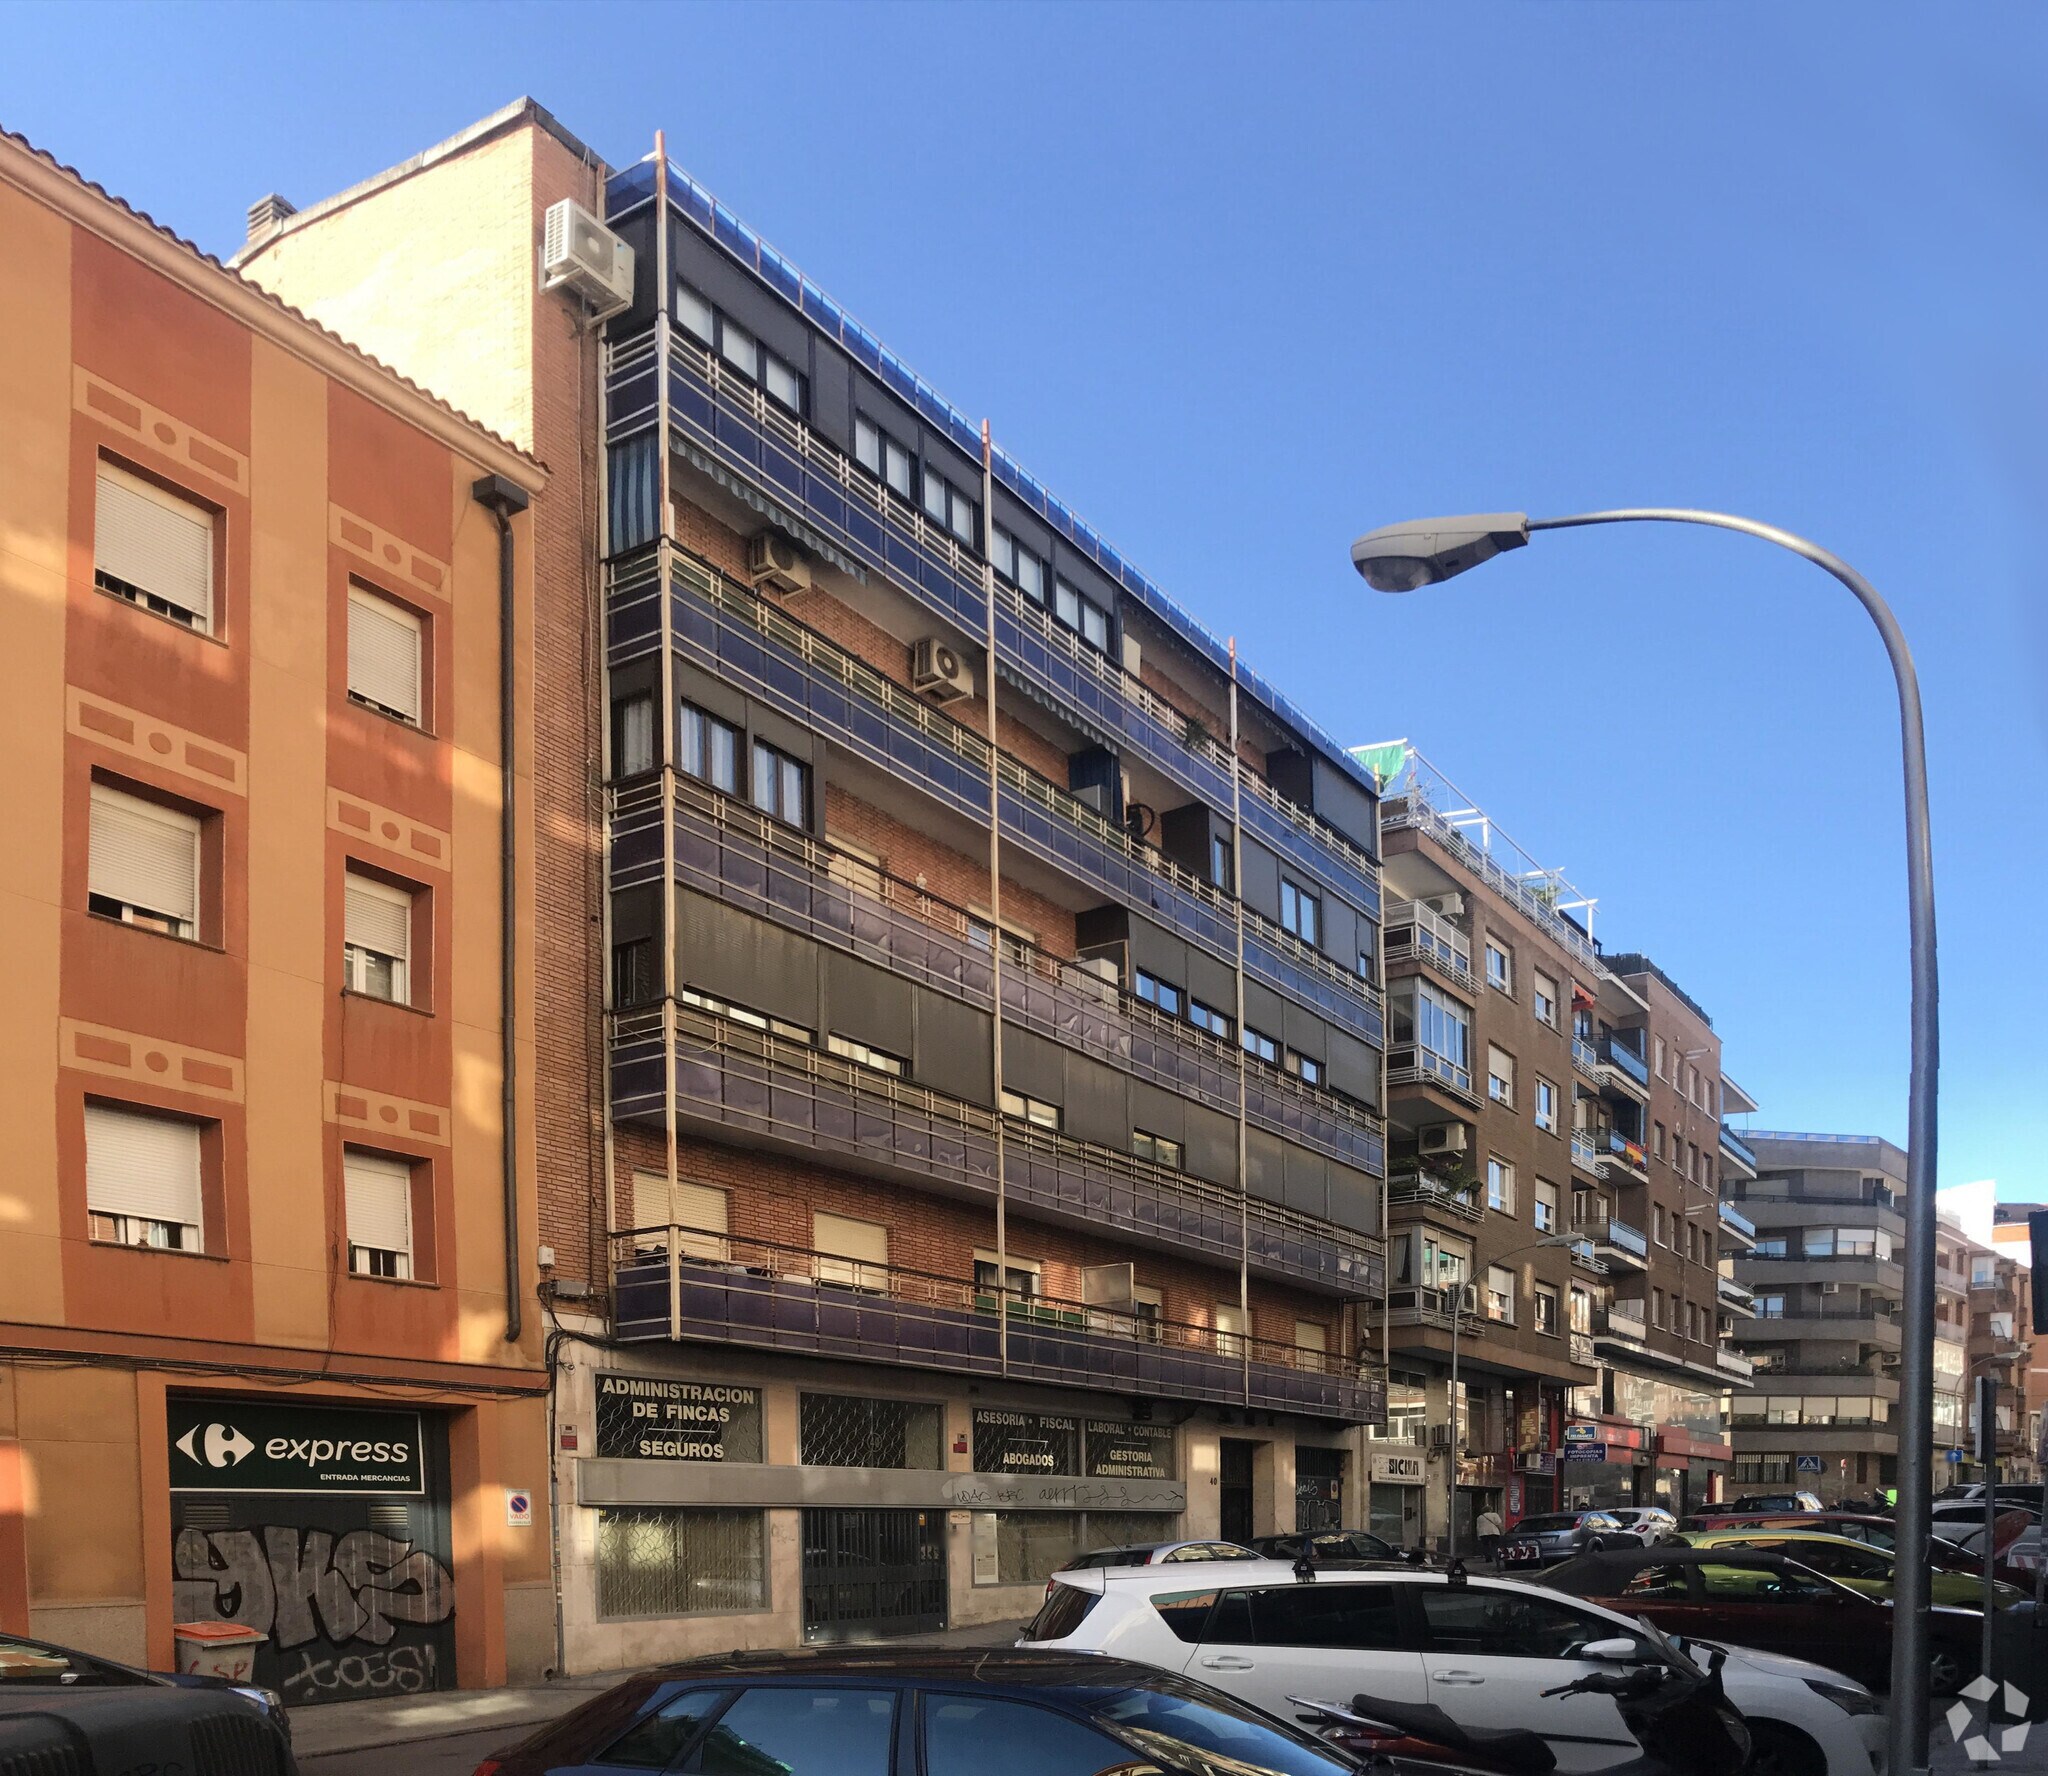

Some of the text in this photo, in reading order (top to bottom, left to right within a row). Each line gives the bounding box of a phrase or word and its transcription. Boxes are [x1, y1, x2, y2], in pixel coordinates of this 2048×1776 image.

[602, 1378, 755, 1405] ADMINISTRACION
[632, 1401, 730, 1423] DE FINCAS
[976, 1410, 1075, 1431] ASESORIA FISCAL
[1088, 1420, 1172, 1439] LABORAL CONTABLE
[265, 1437, 409, 1468] express
[639, 1439, 725, 1459] SEGUROS
[1109, 1449, 1153, 1463] GESTORIA
[1002, 1452, 1055, 1467] ABOGADOS
[320, 1473, 411, 1482] ENTRADA MERCANCIAS
[1095, 1463, 1166, 1478] ADMINISTRATIVA
[1209, 1477, 1218, 1486] 40
